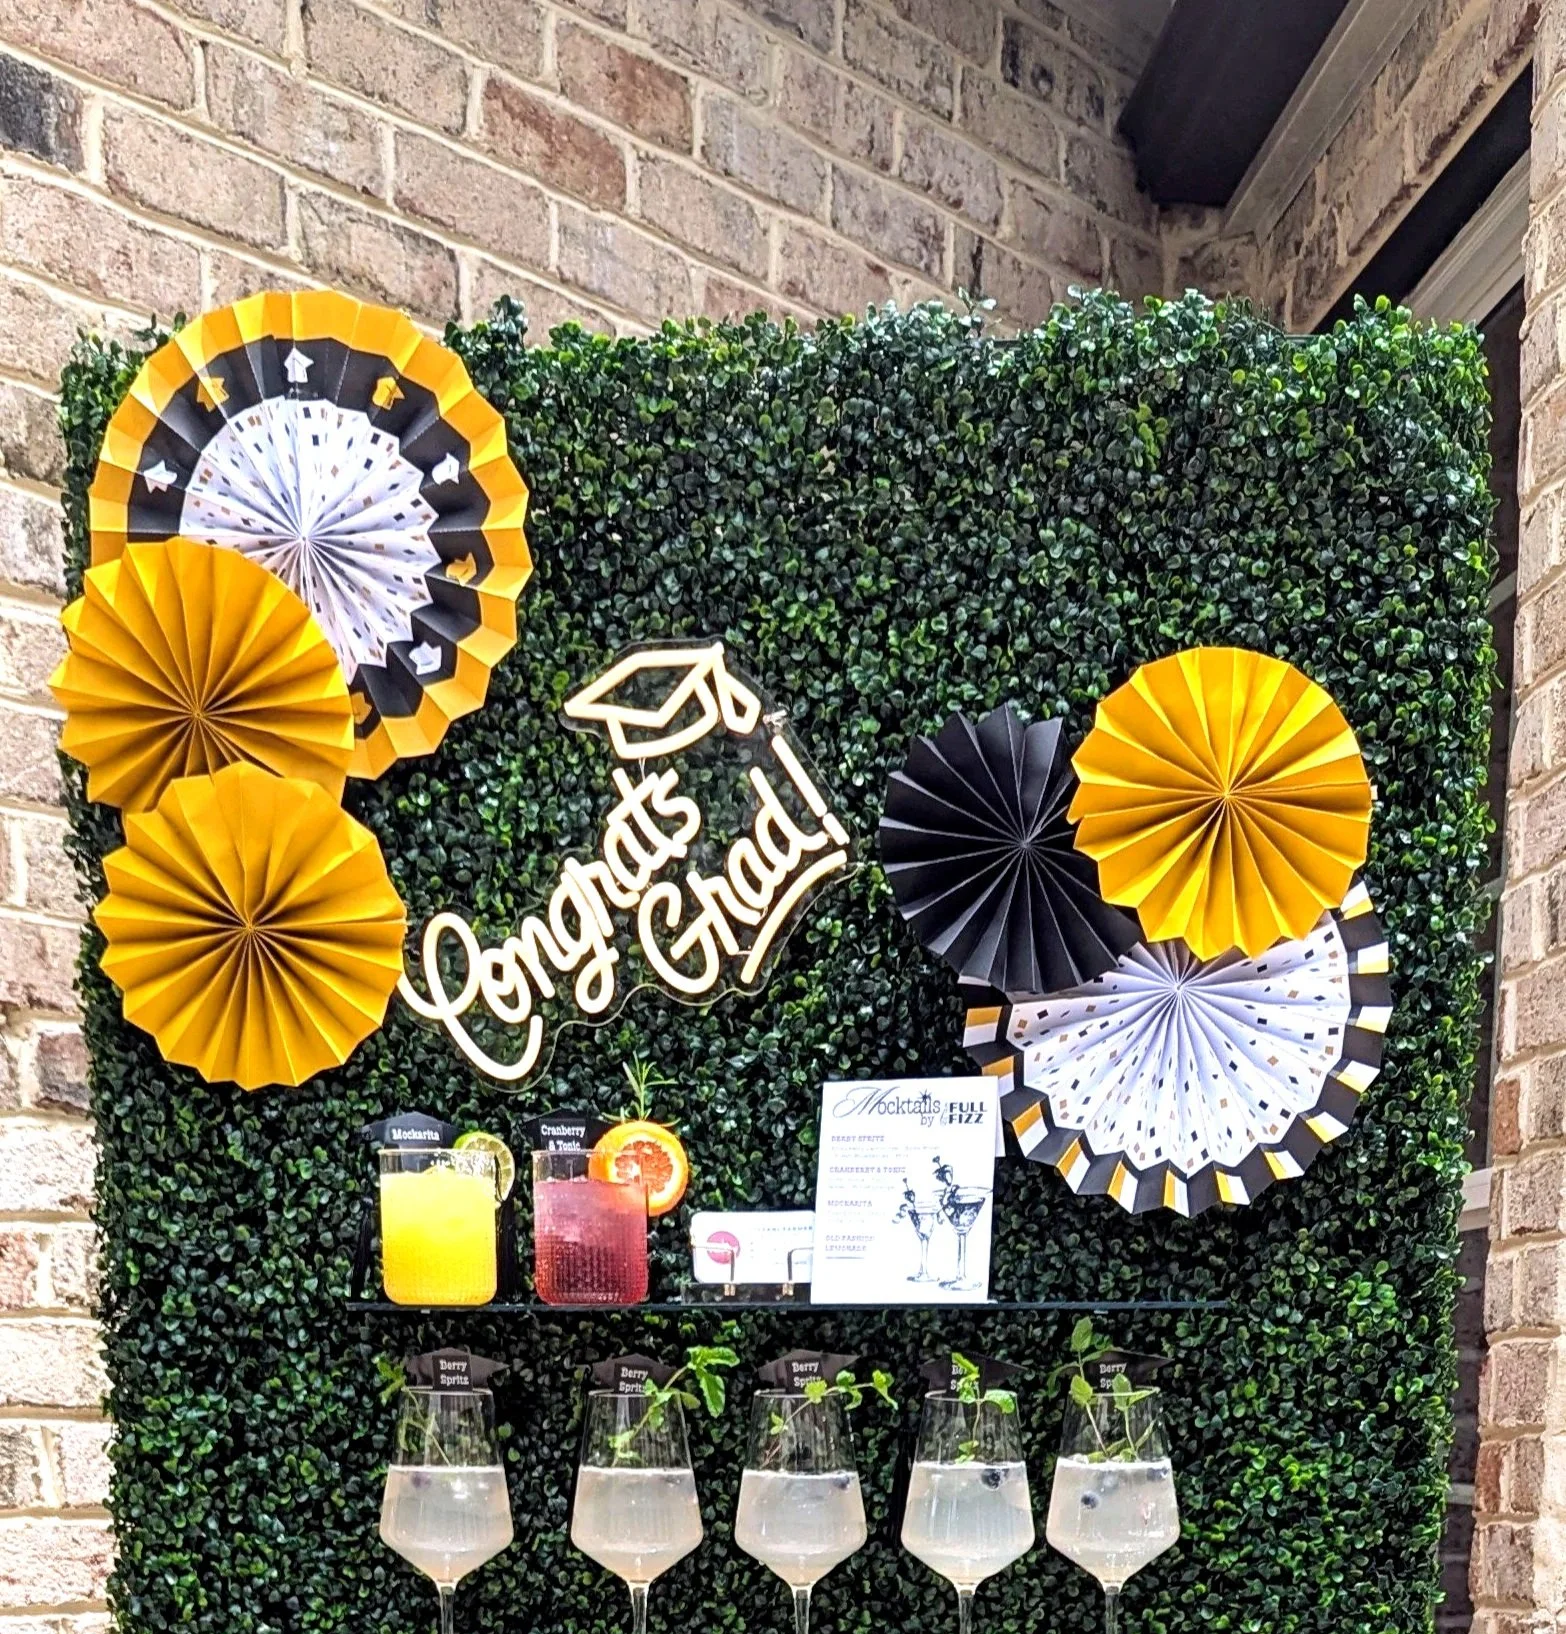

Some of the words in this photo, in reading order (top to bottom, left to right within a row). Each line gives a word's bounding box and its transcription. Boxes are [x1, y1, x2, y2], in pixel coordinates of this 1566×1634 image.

[638, 735, 850, 994] Grad!
[398, 767, 701, 1081] Congrats
[832, 1086, 941, 1119] Mocktails
[949, 1101, 988, 1113] FULL
[920, 1113, 934, 1128] by
[948, 1113, 984, 1125] FIZZ
[391, 1128, 440, 1142] Mockarita
[541, 1124, 586, 1138] Cranberry
[548, 1140, 556, 1151] &
[556, 1140, 581, 1151] Tonic
[440, 1359, 467, 1372] Berry
[791, 1361, 819, 1373] Berry
[1100, 1363, 1127, 1374] Berry
[621, 1366, 648, 1381] Berry
[440, 1374, 469, 1387] Spritz
